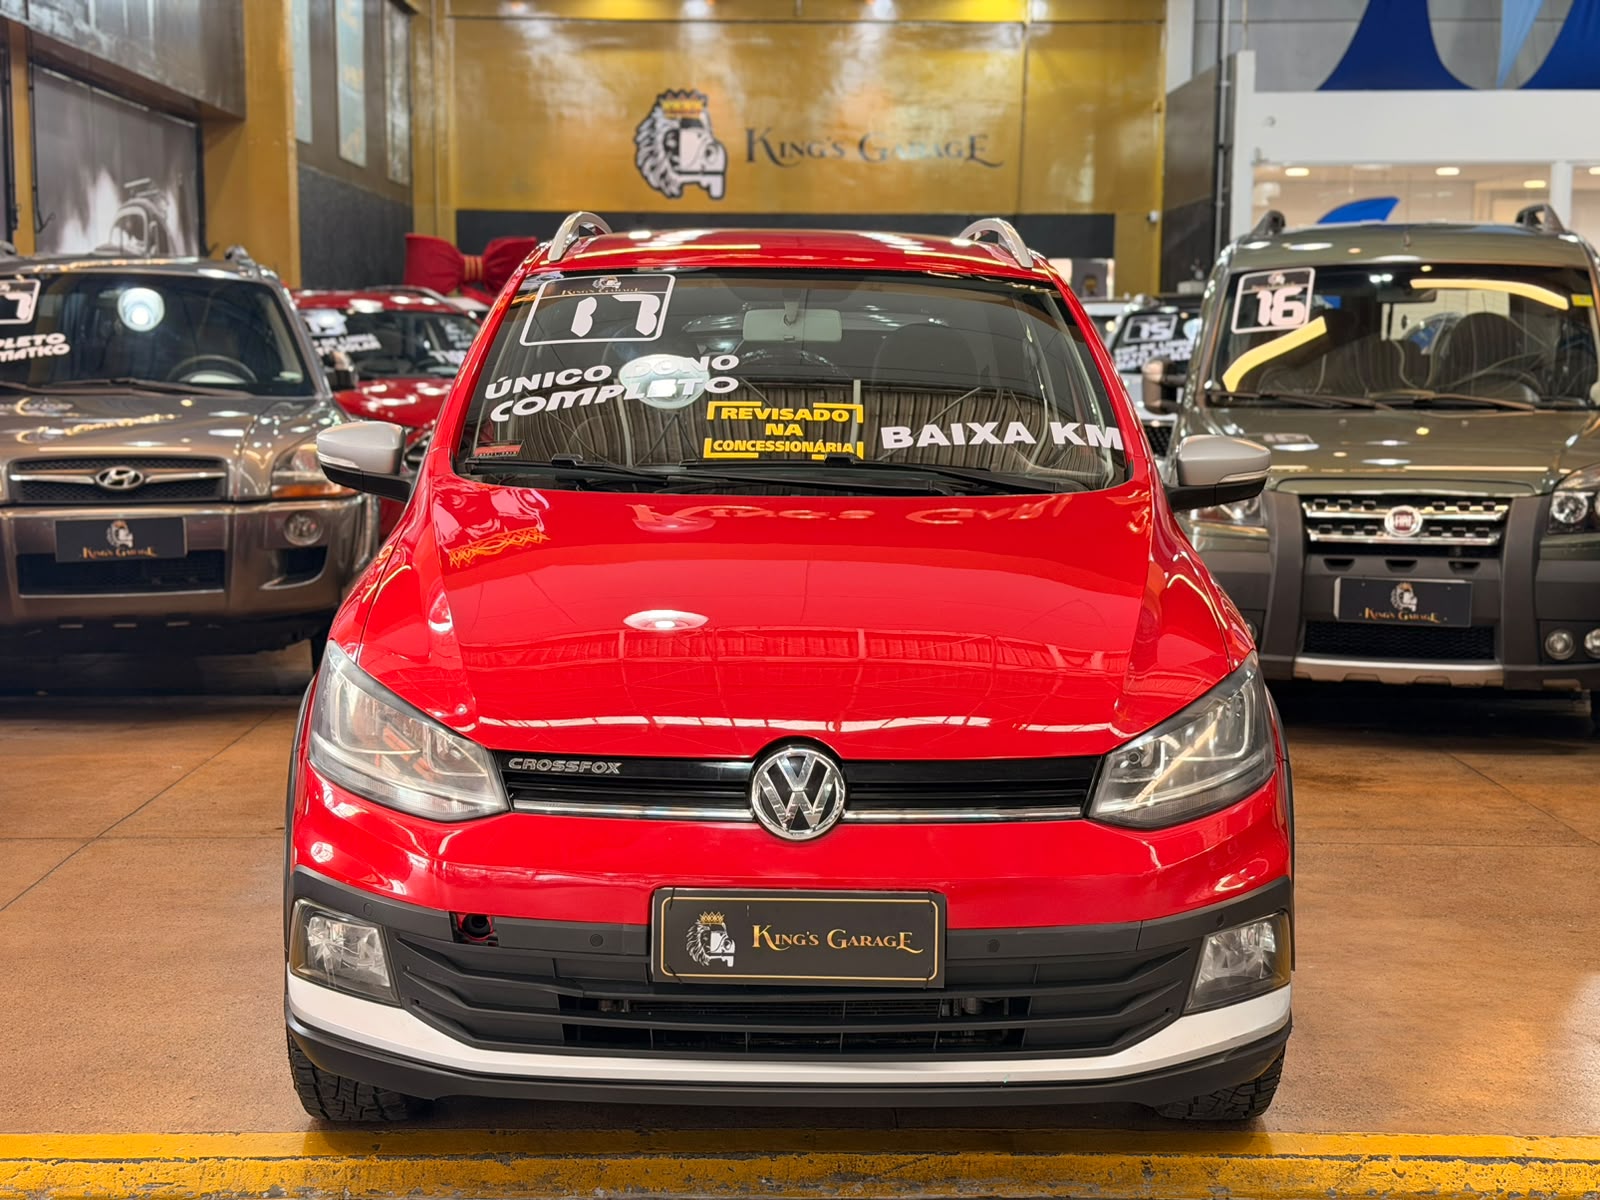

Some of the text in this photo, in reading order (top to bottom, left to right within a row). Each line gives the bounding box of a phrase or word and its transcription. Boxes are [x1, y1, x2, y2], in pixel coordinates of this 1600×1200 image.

[570, 294, 661, 338] 17
[1256, 286, 1306, 326] 16
[1135, 320, 1171, 340] 15
[485, 354, 740, 400] ÚNICO DONO
[490, 376, 739, 423] COMPLETO
[720, 407, 850, 422] REVISADO
[764, 422, 803, 436] NA
[881, 421, 1125, 450] BAIXA KM
[713, 438, 854, 453] CONCESSIONÁRIA
[508, 757, 621, 775] CROSSFOX
